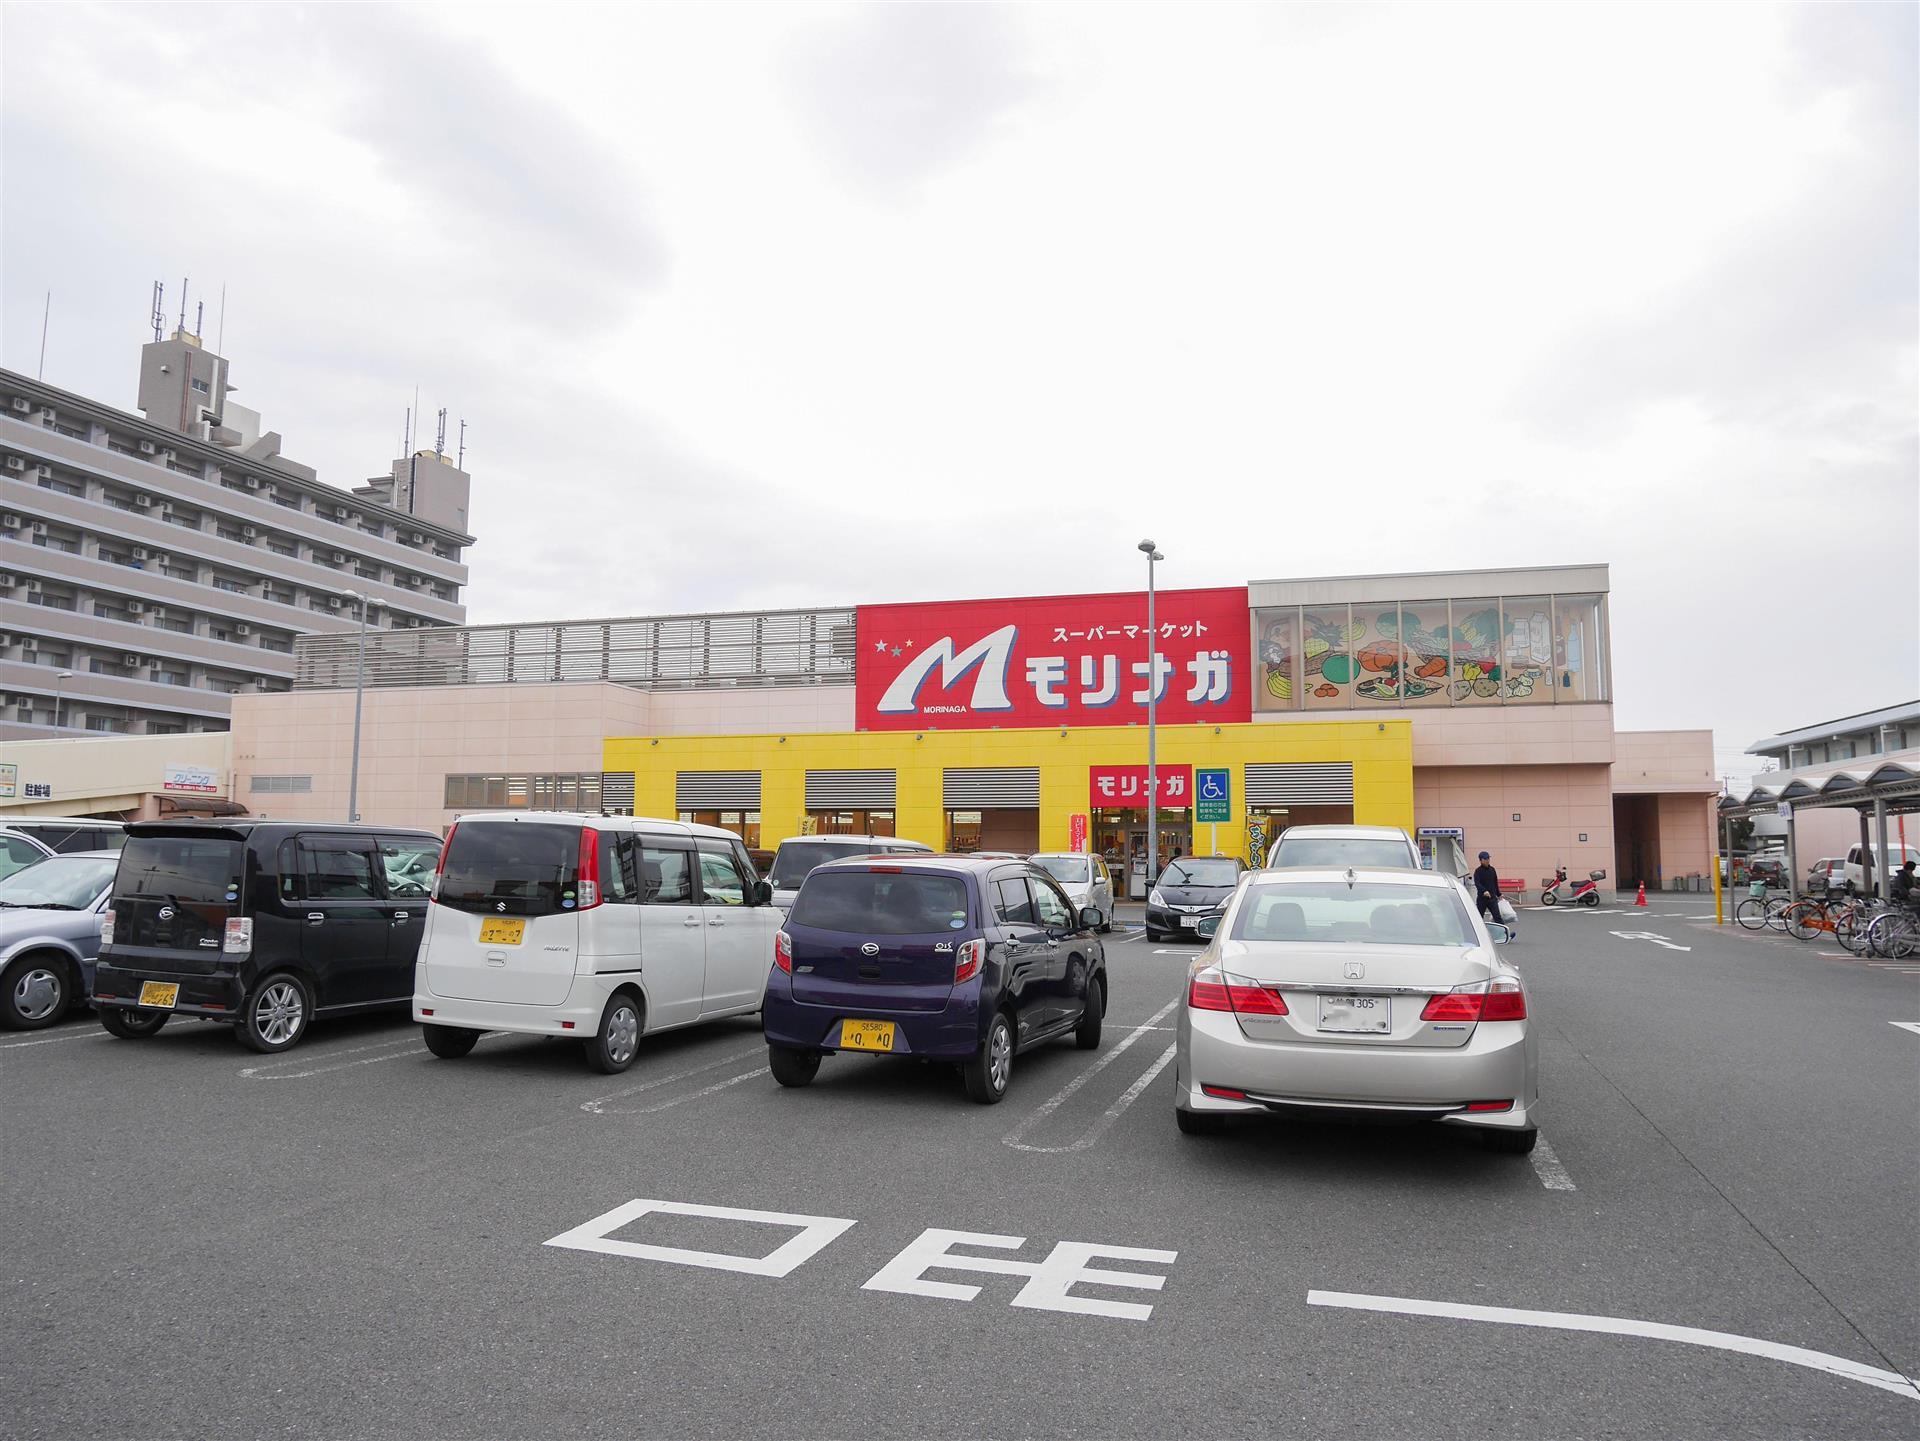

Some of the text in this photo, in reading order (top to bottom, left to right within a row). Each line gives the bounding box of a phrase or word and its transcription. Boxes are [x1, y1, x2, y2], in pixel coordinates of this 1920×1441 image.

[1053, 620, 1208, 643] スーパーマーケット
[1025, 650, 1231, 707] モリナガ
[923, 705, 967, 714] MORINAGA
[1097, 775, 1185, 797] モリナガ
